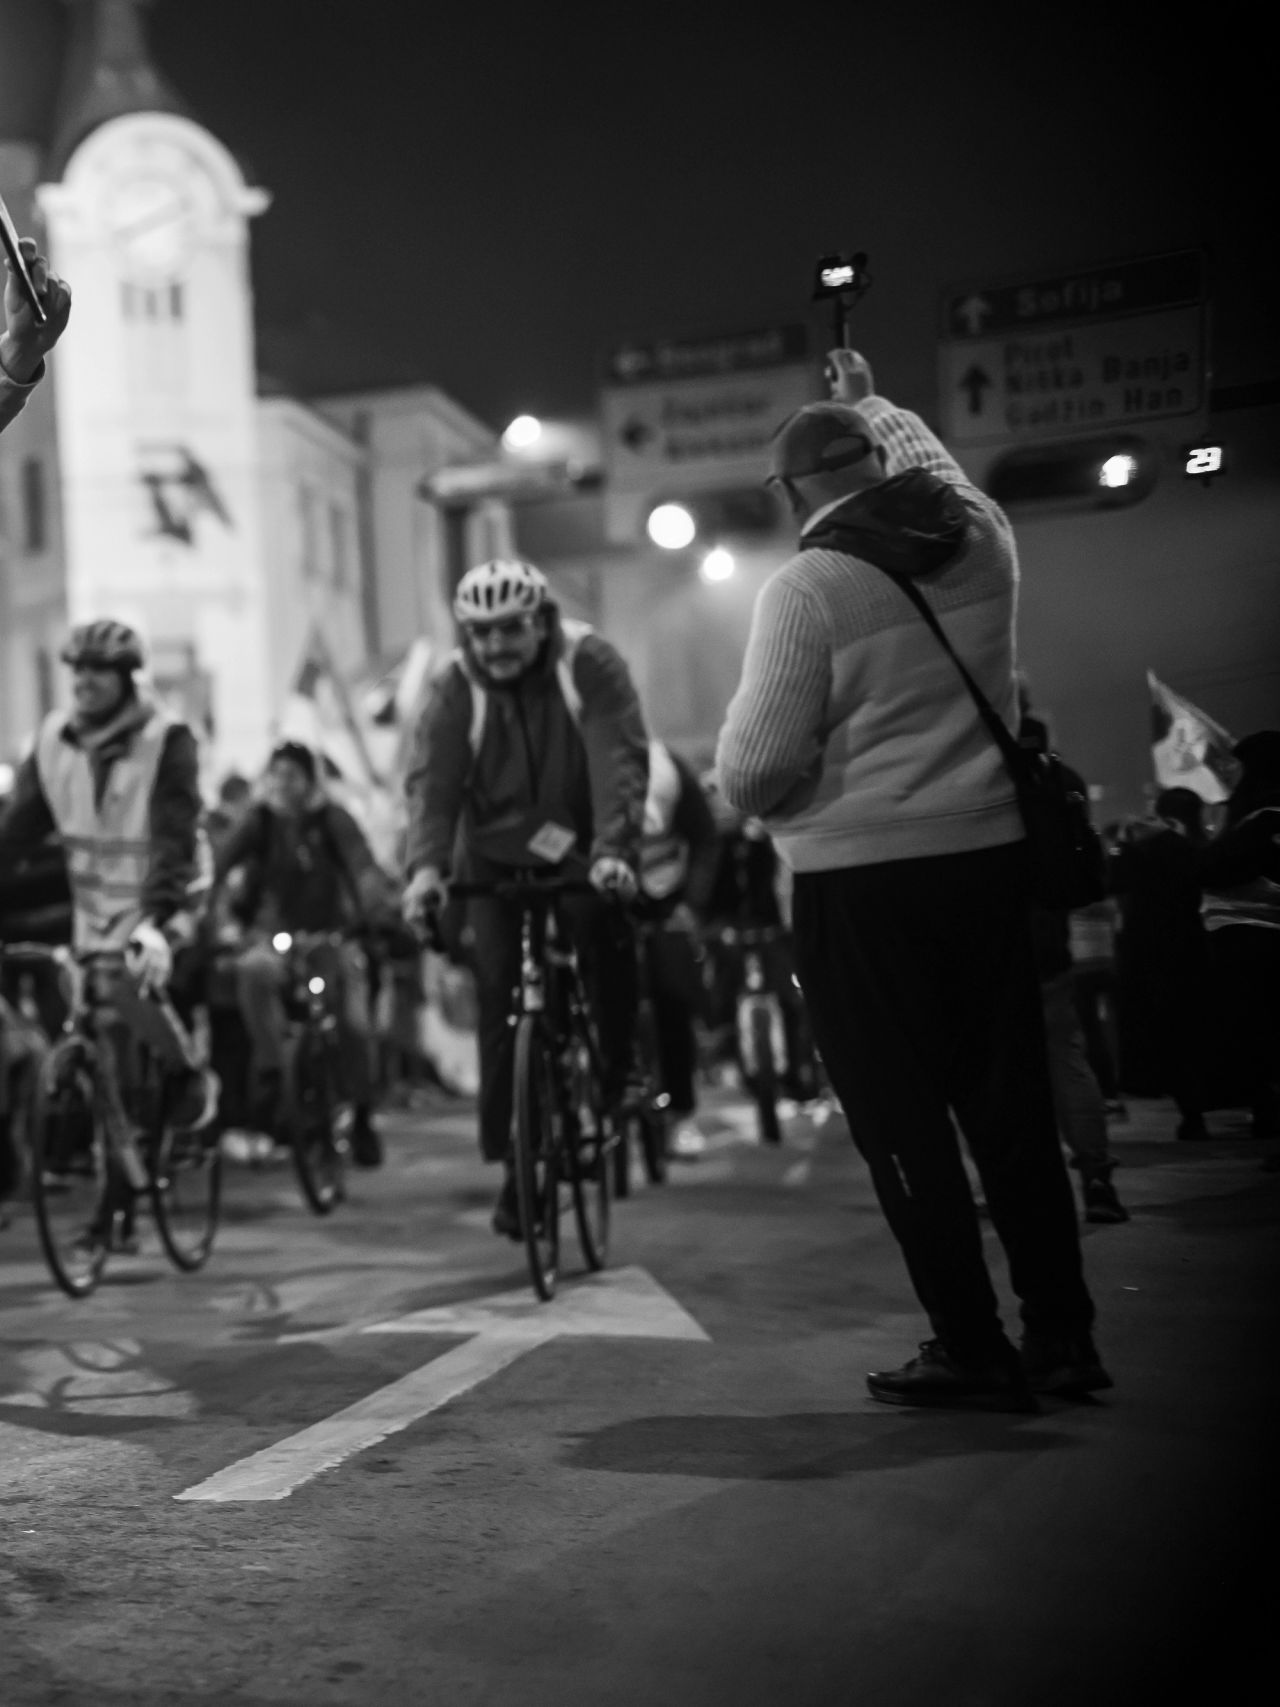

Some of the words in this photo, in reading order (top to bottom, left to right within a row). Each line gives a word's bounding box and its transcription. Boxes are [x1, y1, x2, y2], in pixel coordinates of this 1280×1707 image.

[1016, 280, 1123, 316] Sofija
[1102, 350, 1189, 383] Banja
[1124, 388, 1183, 413] Han
